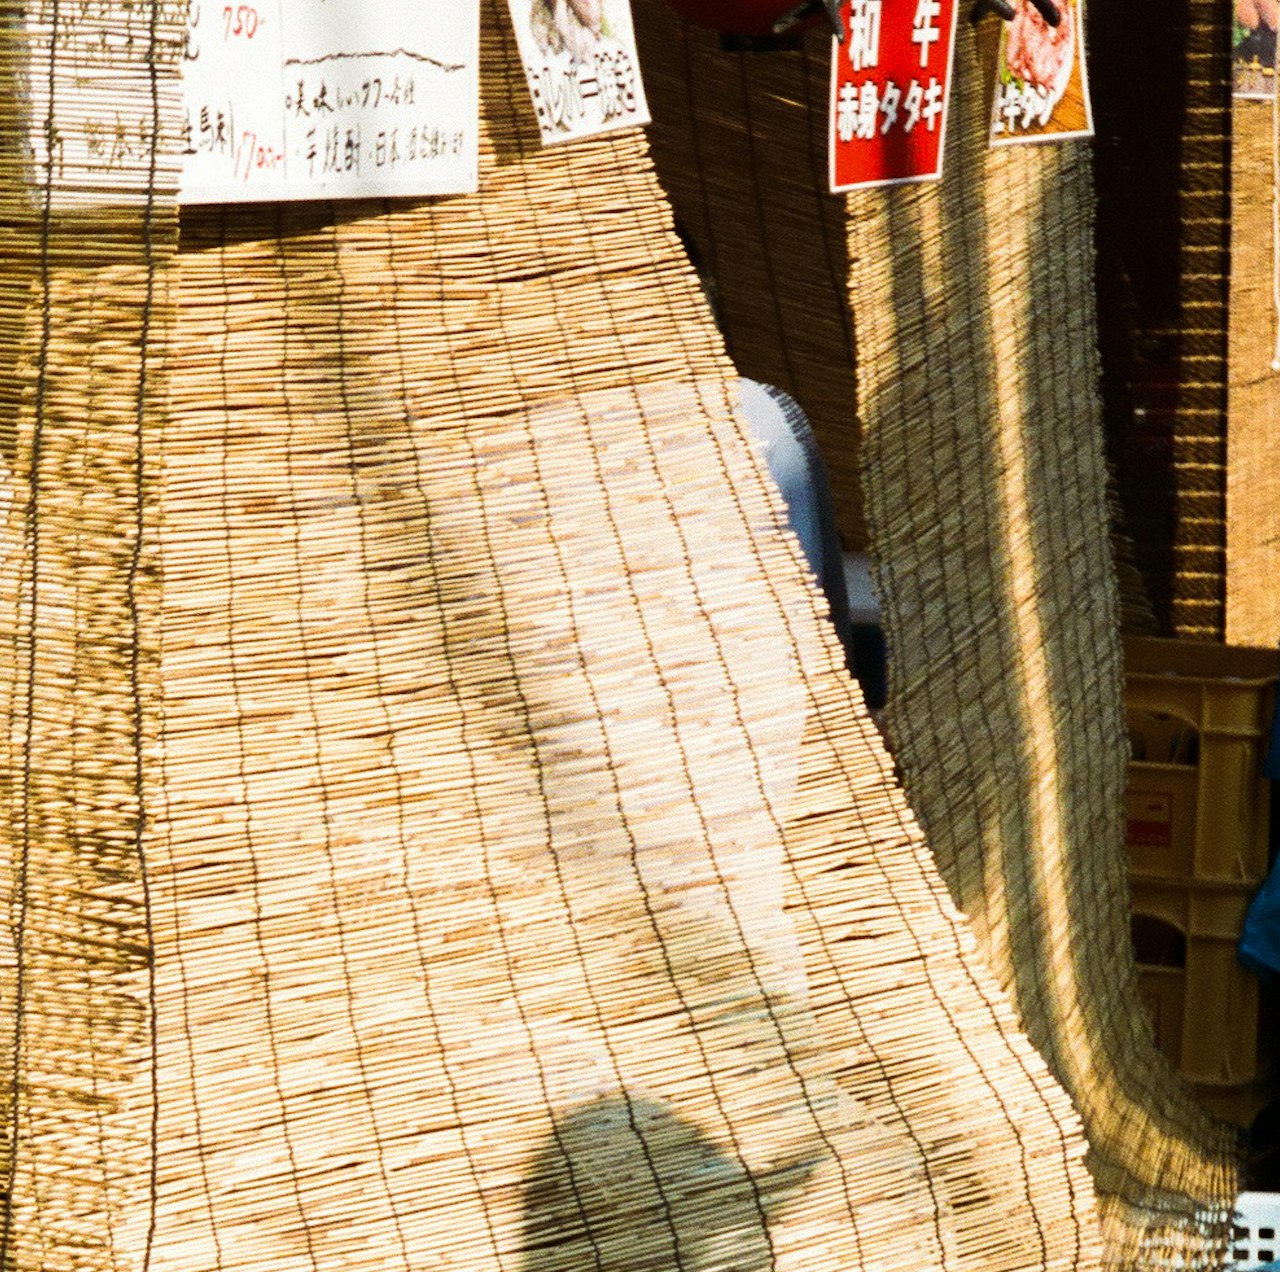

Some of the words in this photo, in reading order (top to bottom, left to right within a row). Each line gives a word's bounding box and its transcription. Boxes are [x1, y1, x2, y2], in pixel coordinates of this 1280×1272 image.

[836, 76, 944, 142] 赤身タタキ
